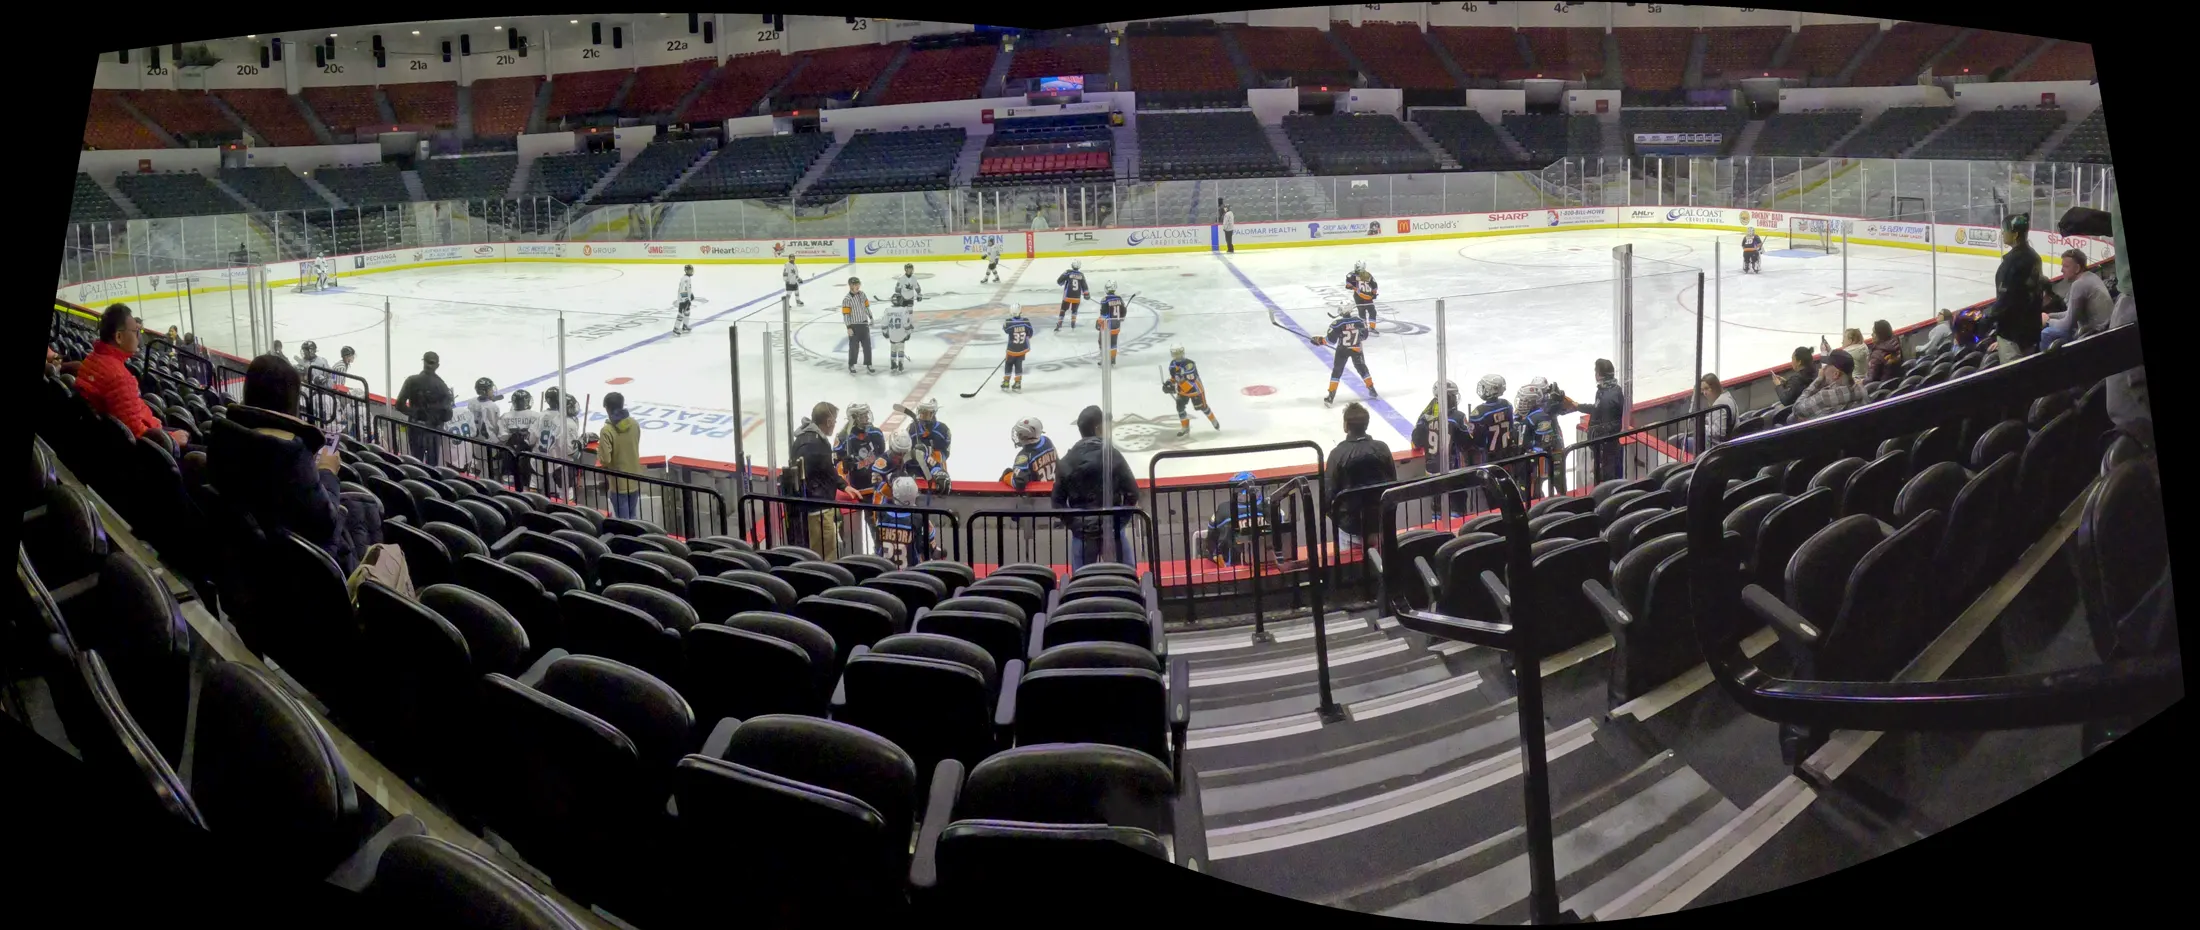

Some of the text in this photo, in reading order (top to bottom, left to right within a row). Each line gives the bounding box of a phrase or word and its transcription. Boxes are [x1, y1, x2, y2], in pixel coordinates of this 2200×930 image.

[1461, 2, 1477, 12] 4b
[1554, 3, 1569, 13] 4c
[1647, 3, 1661, 13] 5a
[852, 19, 867, 30] 23
[758, 30, 780, 41] 22b
[667, 40, 688, 51] 22a
[582, 49, 600, 59] 21c
[410, 60, 428, 70] 21a
[496, 55, 515, 65] 21b
[147, 65, 168, 76] 20a
[237, 65, 259, 75] 20b
[323, 63, 344, 73] 20c
[1488, 212, 1529, 222] SHARP
[1696, 209, 1723, 217] COAST
[1412, 221, 1458, 231] McDonald's
[1756, 219, 1778, 228] LOBSTER
[1065, 232, 1093, 241] TCS
[1141, 229, 1199, 240] CAL COAST
[1233, 227, 1266, 236] PALOMAR
[877, 238, 933, 249] CAL COAST
[2047, 235, 2087, 249] SHARP
[366, 253, 397, 261] PECHANGA
[1072, 279, 1078, 291] 9
[1342, 329, 1359, 346] 27
